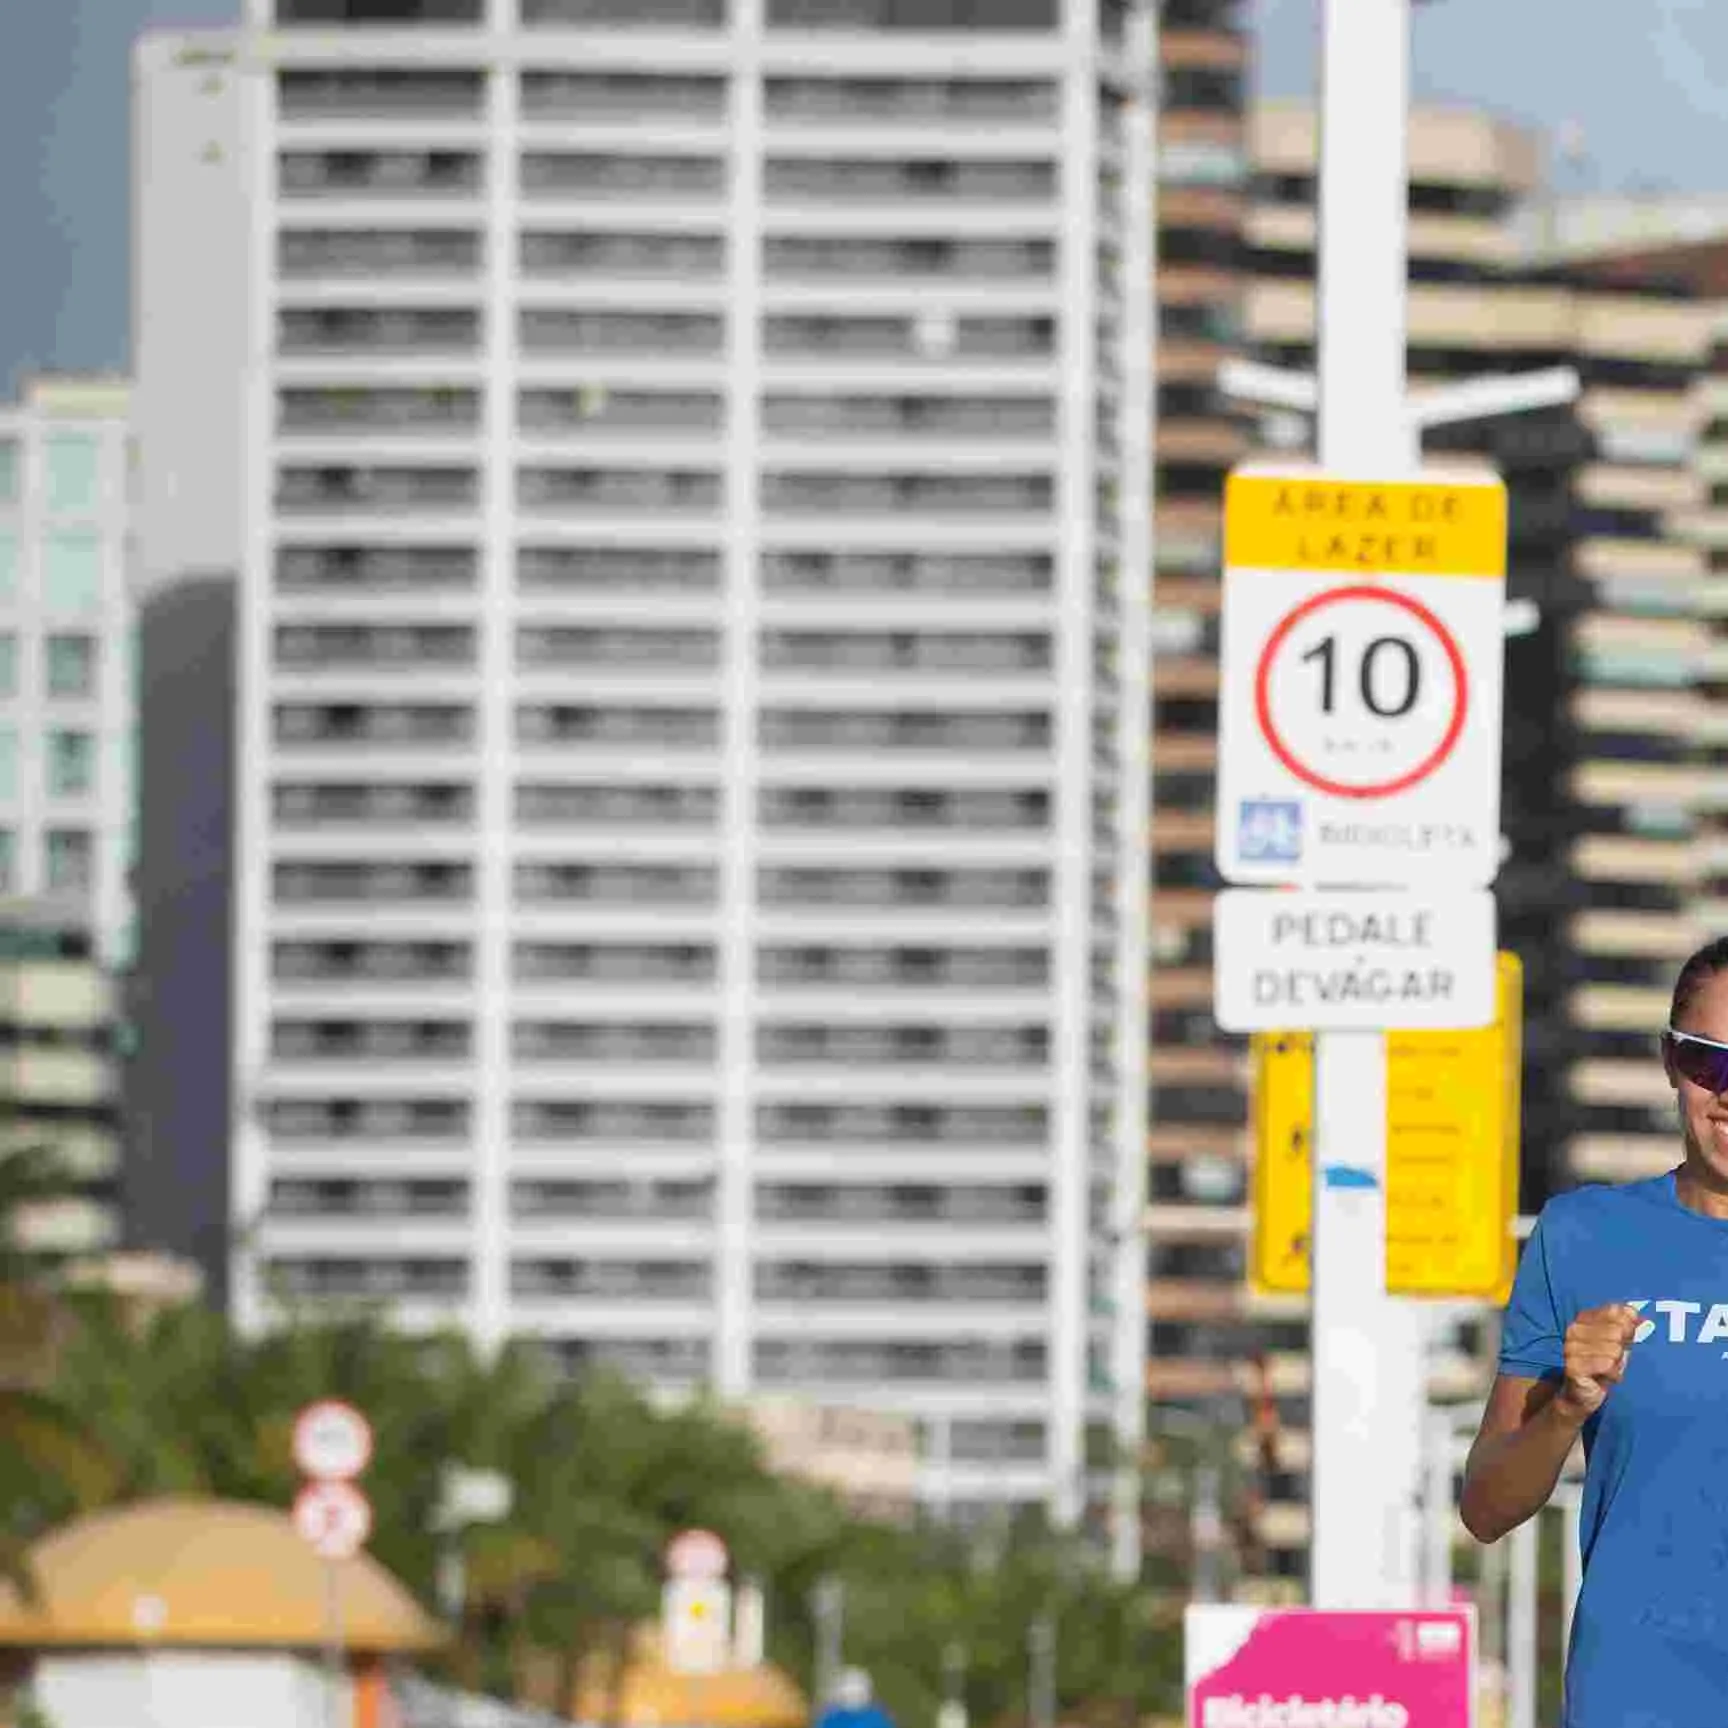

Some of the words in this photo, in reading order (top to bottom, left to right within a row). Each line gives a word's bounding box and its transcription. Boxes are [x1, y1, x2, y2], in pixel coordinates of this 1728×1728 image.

[1302, 635, 1420, 717] 10
[1271, 910, 1432, 947] PEDALE
[1253, 967, 1455, 1006] DEVAGAR
